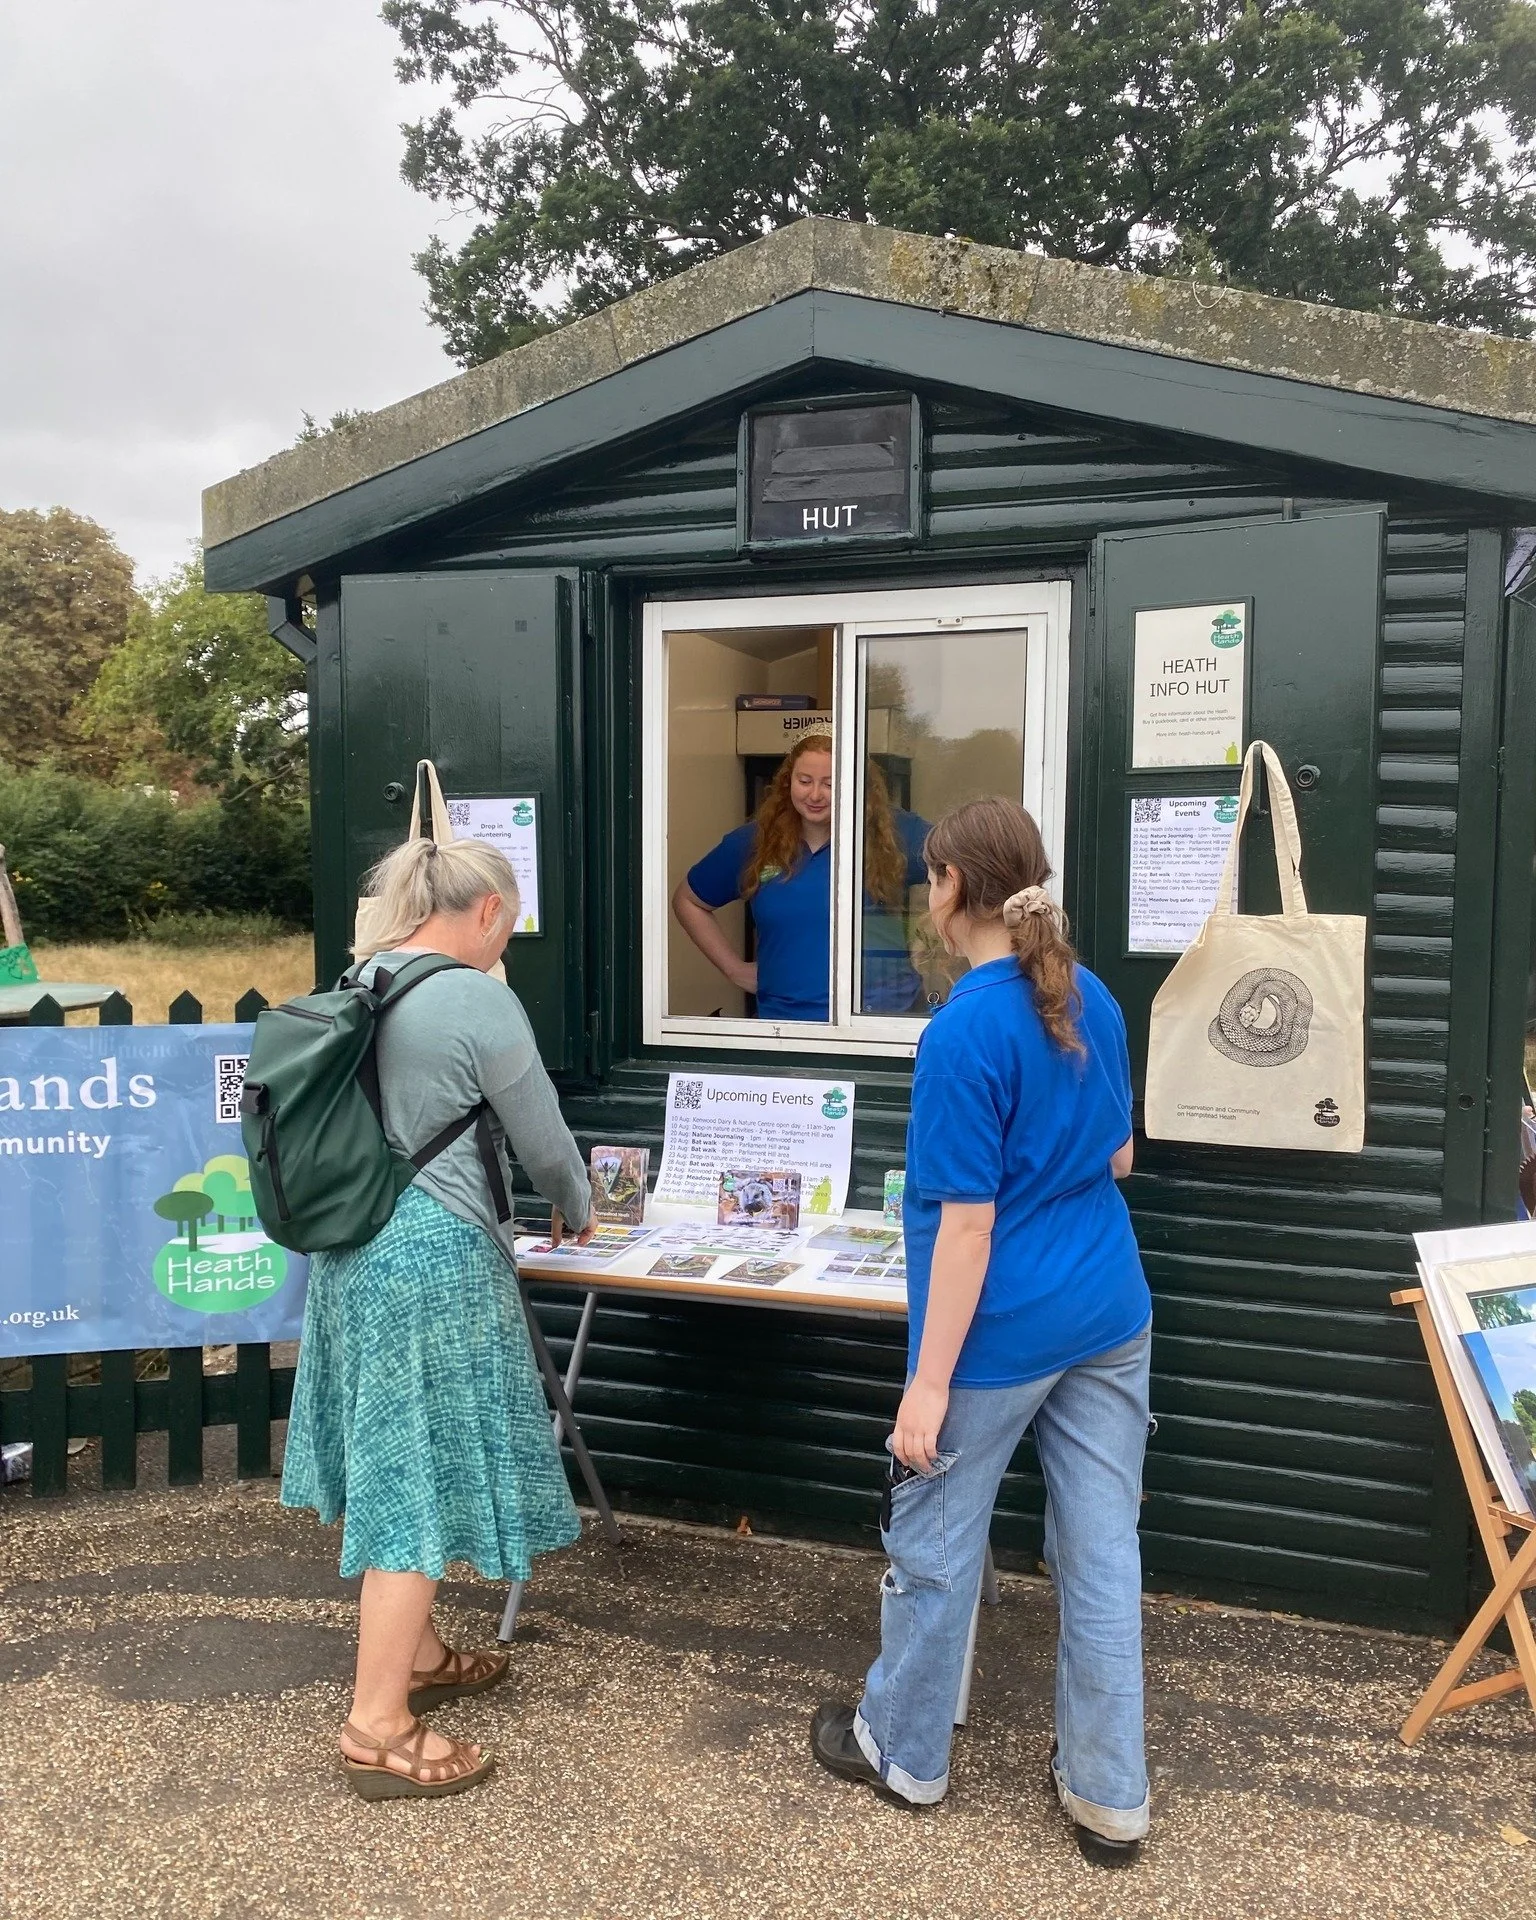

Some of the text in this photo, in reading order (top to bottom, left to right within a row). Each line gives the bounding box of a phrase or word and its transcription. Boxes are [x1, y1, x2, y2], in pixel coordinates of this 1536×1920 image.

[802, 504, 858, 530] HUT
[1163, 658, 1217, 674] HEATH
[1150, 679, 1230, 697] INFO HUT
[0, 1056, 156, 1112] ands
[707, 1089, 813, 1105] Upcoming Events
[1228, 1107, 1260, 1115] Community
[0, 1131, 111, 1158] munity
[745, 1164, 773, 1172] Parliament
[168, 1252, 271, 1275] Heath
[169, 1271, 275, 1294] Hands
[0, 1304, 80, 1328] .org.uk
